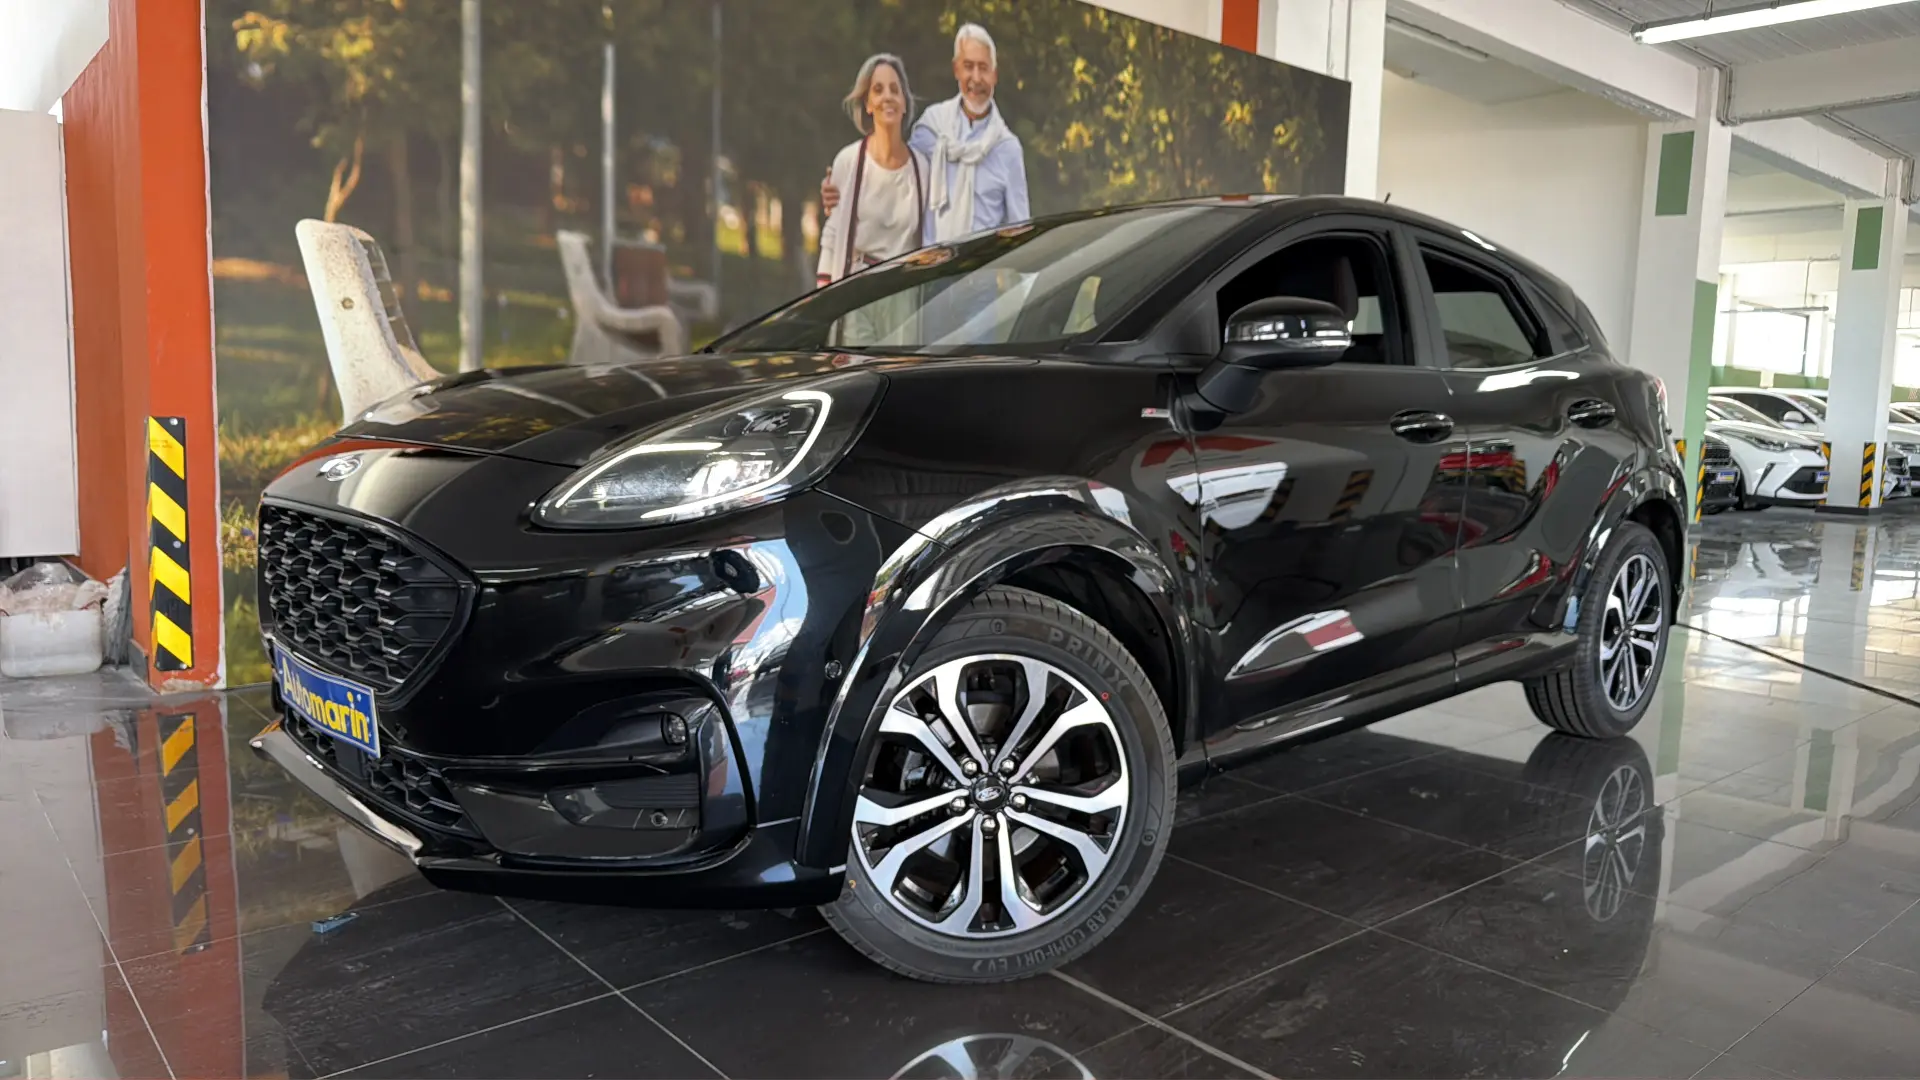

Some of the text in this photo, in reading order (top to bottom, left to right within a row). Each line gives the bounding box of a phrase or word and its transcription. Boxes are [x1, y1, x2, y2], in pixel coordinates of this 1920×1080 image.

[1047, 626, 1130, 693] PRINX
[281, 656, 370, 744] Automarin
[1016, 930, 1086, 967] COMFORT
